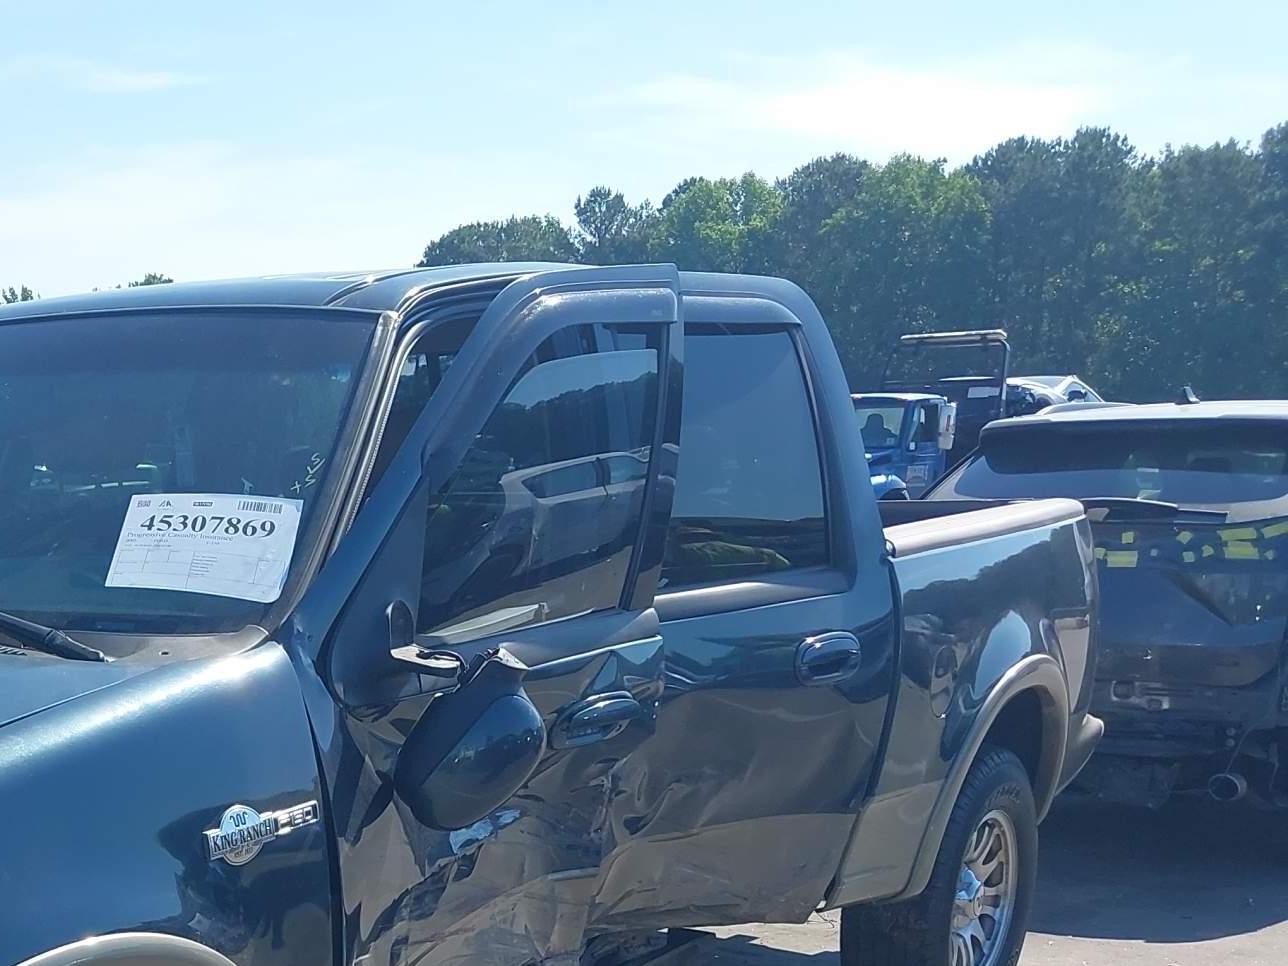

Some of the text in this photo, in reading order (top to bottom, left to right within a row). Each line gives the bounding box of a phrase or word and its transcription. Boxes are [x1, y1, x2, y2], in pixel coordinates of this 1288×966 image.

[140, 514, 276, 539] 45307869
[168, 532, 199, 540] Casualty
[211, 830, 238, 853] KING
[239, 817, 273, 845] RANCH
